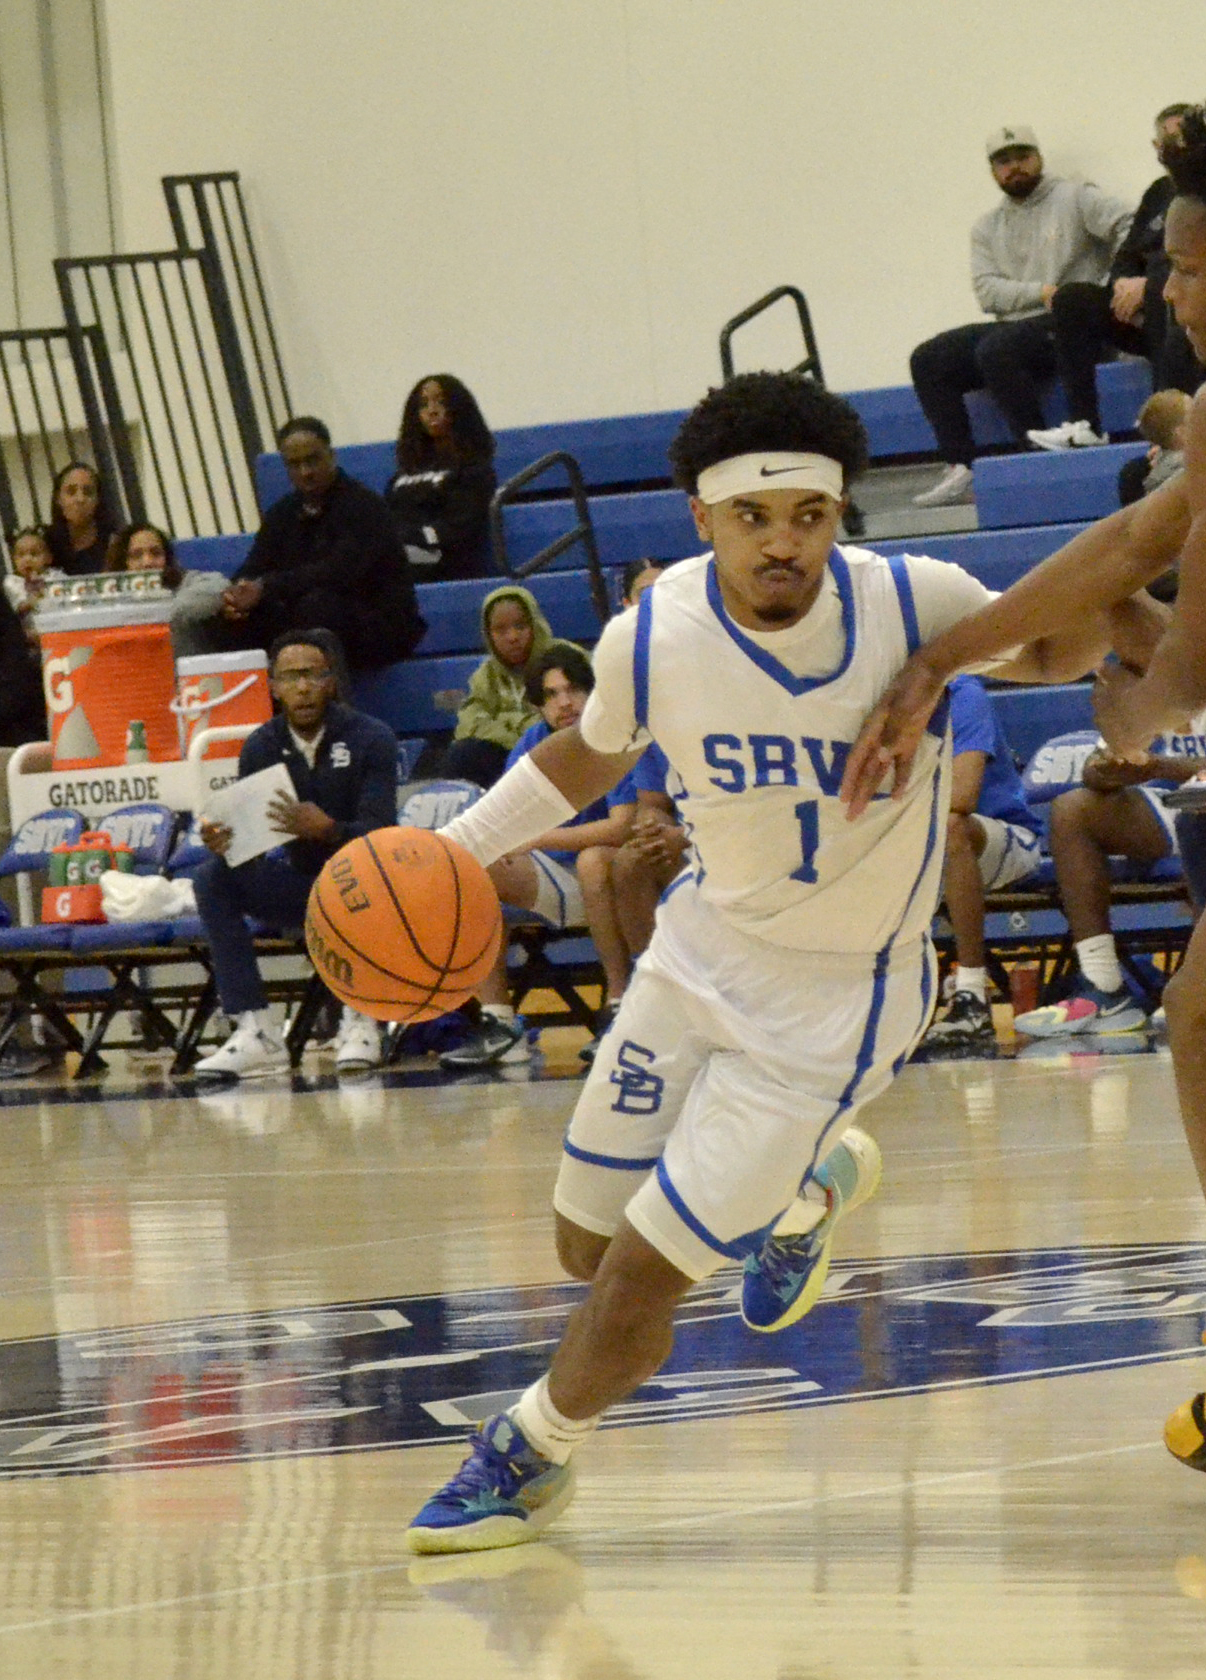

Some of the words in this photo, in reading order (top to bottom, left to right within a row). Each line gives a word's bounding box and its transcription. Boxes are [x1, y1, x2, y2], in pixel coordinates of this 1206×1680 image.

[44, 658, 74, 712] G
[49, 776, 159, 807] GATORADE
[703, 733, 891, 800] SBV
[790, 800, 819, 884] 1
